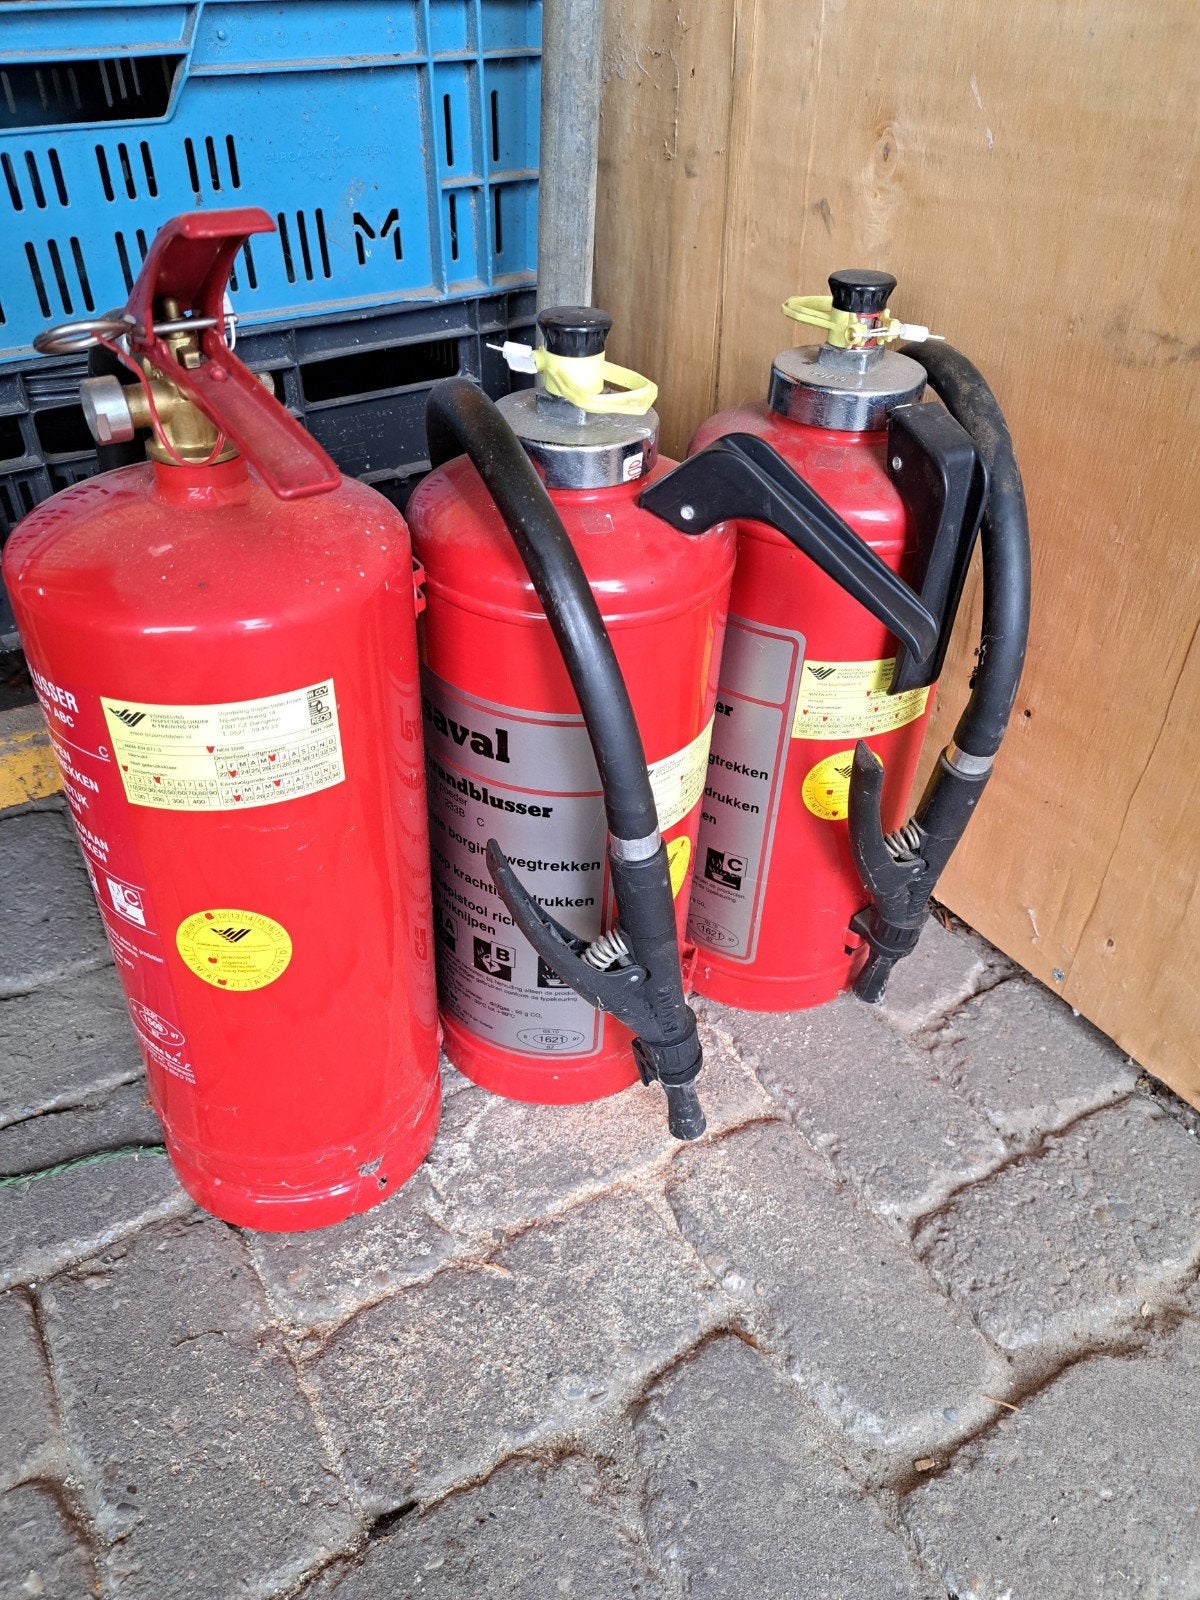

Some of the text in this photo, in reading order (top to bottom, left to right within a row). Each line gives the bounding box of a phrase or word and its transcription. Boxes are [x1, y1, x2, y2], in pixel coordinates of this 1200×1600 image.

[353, 208, 403, 266] M
[54, 706, 74, 728] ABC
[715, 701, 734, 717] er
[421, 696, 510, 764] saval
[98, 746, 108, 758] C
[708, 753, 769, 781] gtrekken
[704, 786, 760, 814] drukken
[476, 818, 485, 827] C
[448, 826, 600, 872] borgin wegtrekken
[727, 858, 743, 872] C
[124, 889, 140, 906] C
[701, 926, 723, 940] 1621
[496, 946, 510, 962] B
[539, 1036, 564, 1044] 1621
